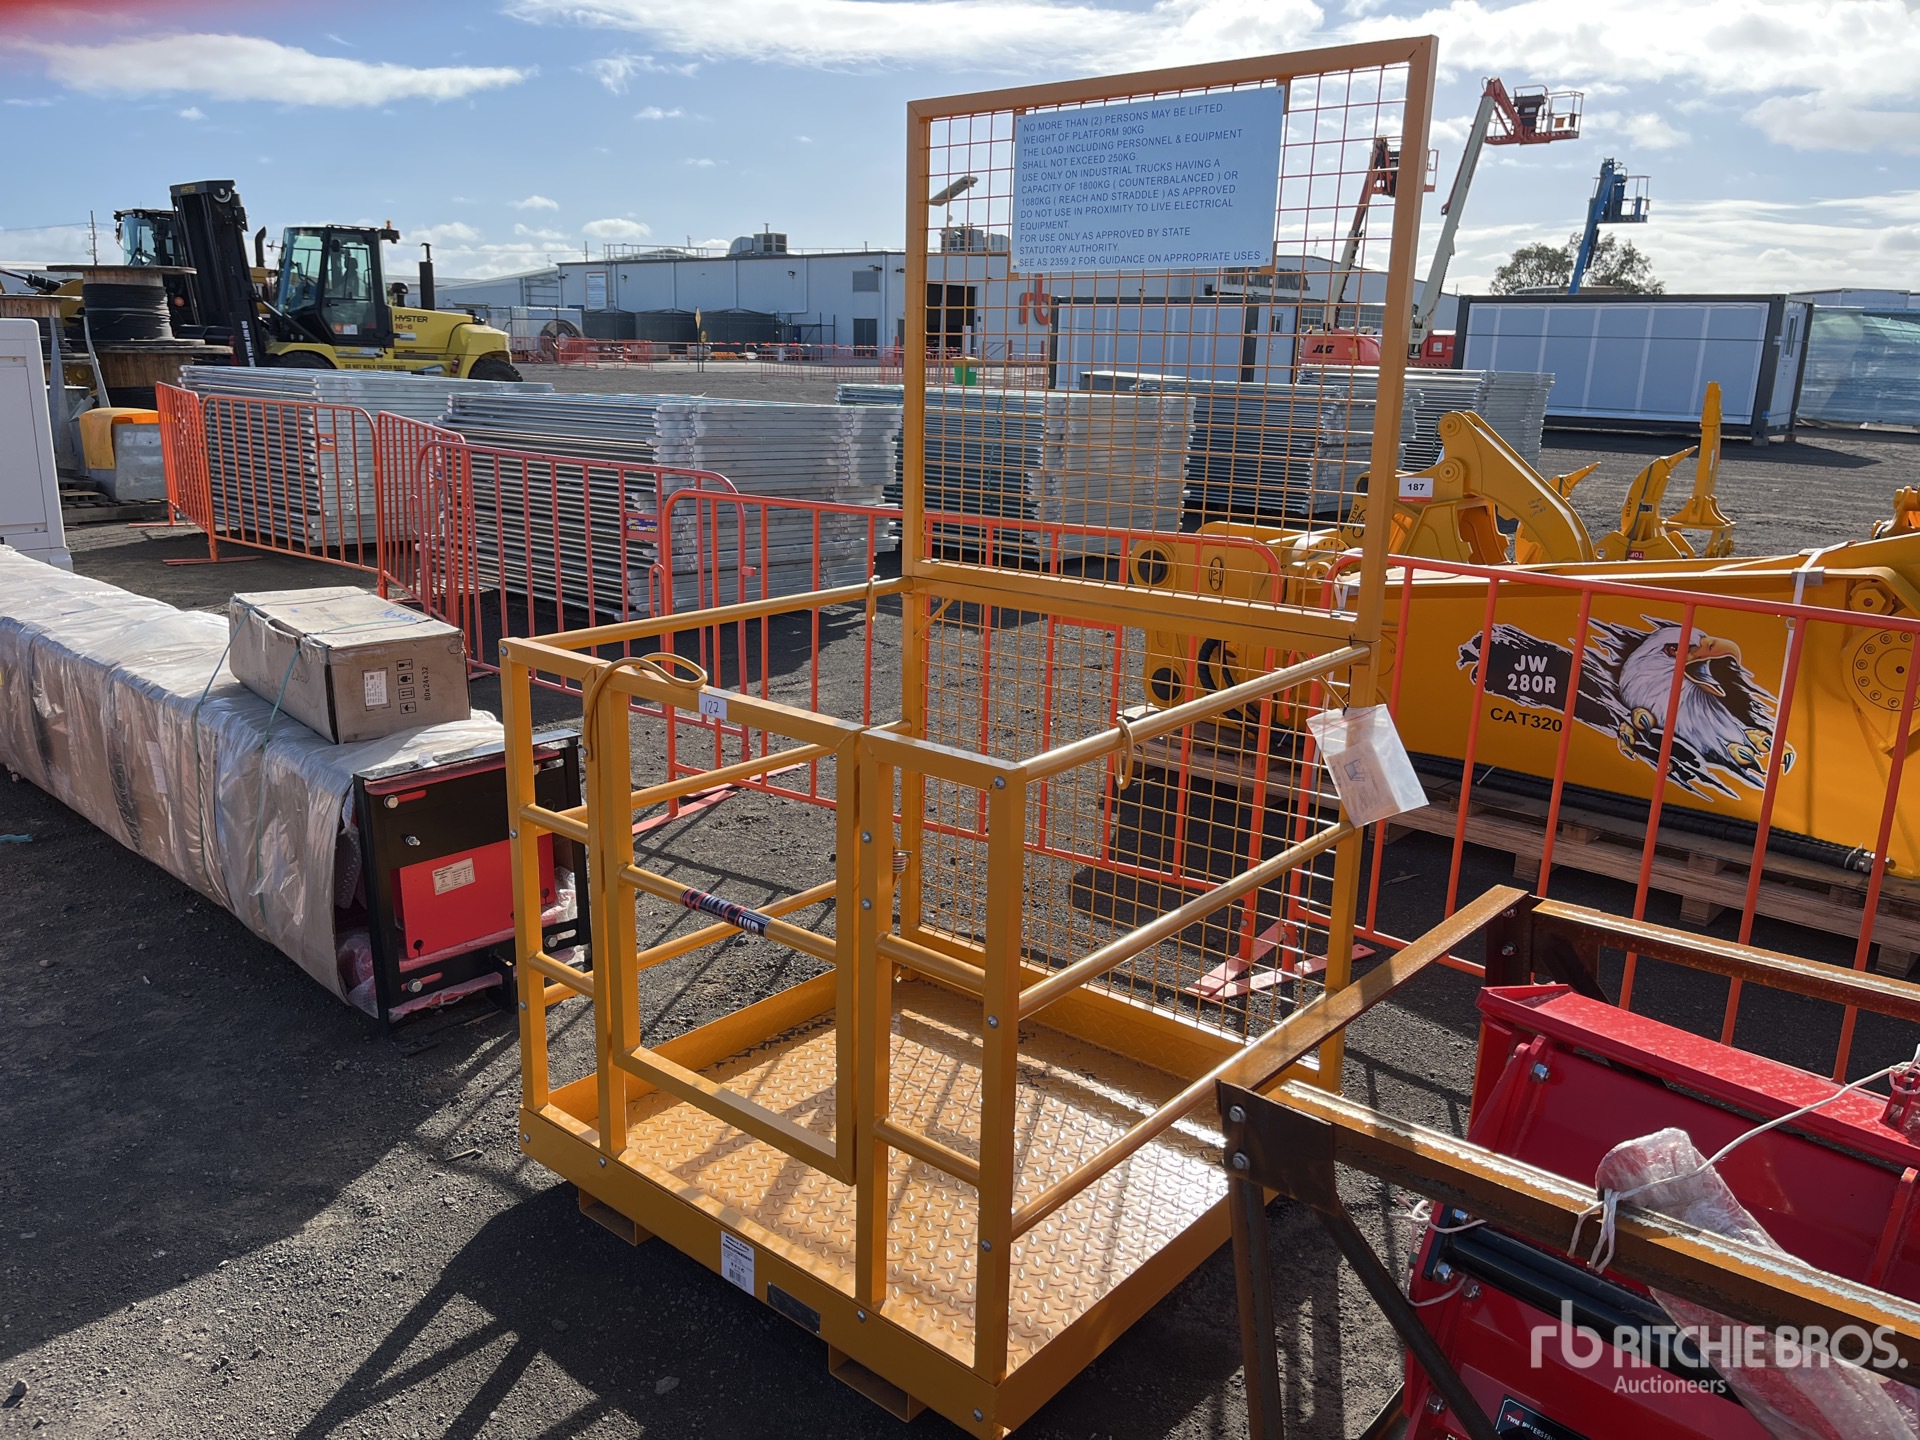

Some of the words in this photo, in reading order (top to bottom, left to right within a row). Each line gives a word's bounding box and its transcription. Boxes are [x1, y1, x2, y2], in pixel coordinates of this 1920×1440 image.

[1023, 123, 1036, 132] NO
[1037, 120, 1062, 131] MORE
[1065, 117, 1088, 128] THAN
[1090, 115, 1102, 127] (2)
[1104, 110, 1148, 124] PERSONS
[1151, 108, 1171, 119] MAY
[1172, 106, 1186, 117] BE
[1188, 102, 1226, 115] LIFTED.
[1022, 133, 1056, 145] WEIGHT
[1057, 131, 1069, 141] OF
[1072, 126, 1119, 140] PLATFORM
[1121, 124, 1144, 135] 90KG
[1022, 147, 1038, 157] THE
[1041, 145, 1064, 156] LOAD
[1066, 140, 1114, 153] INCLUDING
[1116, 134, 1173, 149] PERSONNEL
[1175, 134, 1181, 144] &
[1184, 128, 1243, 143] EQUIPMENT
[1021, 172, 1038, 182] USE
[1040, 170, 1063, 180] ONLY
[1064, 169, 1077, 179] ON
[1080, 164, 1132, 177] INDUSTRIAL
[1134, 161, 1173, 173] TRUCKS
[1175, 158, 1211, 170] HAVING
[1213, 157, 1221, 167] A
[1022, 159, 1048, 170] SHALL
[1050, 157, 1067, 167] NOT
[1070, 154, 1105, 166] EXCEED
[1021, 183, 1062, 194] CAPACITY
[1063, 182, 1075, 191] OF
[1078, 179, 1110, 190] 1800KG
[1118, 171, 1214, 187] COUNTERBALANCED
[1223, 170, 1238, 180] OR
[1021, 196, 1051, 206] 1080KG
[1058, 193, 1087, 204] REACH
[1090, 192, 1108, 202] AND
[1111, 189, 1159, 201] STRADDLE
[1167, 187, 1180, 197] AS
[1020, 209, 1032, 218] DO
[1034, 208, 1052, 218] NOT
[1054, 207, 1071, 217] USE
[1073, 206, 1083, 215] IN
[1085, 203, 1133, 215] PROXIMITY
[1136, 202, 1148, 212] TO
[1150, 201, 1171, 211] LIVE
[1174, 197, 1233, 210] ELECTRICAL
[1019, 233, 1036, 243] FOR
[1038, 232, 1055, 242] USE
[1057, 231, 1080, 241] ONLY
[1081, 231, 1093, 240] AS
[1095, 228, 1144, 240] APPROVED
[1146, 228, 1159, 237] BY
[1161, 226, 1190, 237] STATE
[1018, 257, 1034, 266] SEE
[1036, 257, 1047, 266] AS
[1078, 255, 1096, 265] FOR
[1098, 254, 1145, 264] GUIDANCE
[1147, 253, 1161, 263] ON
[1163, 251, 1230, 262] APPROPRIATE
[1233, 250, 1261, 260] USES
[1019, 244, 1067, 254] STATUTORY
[395, 315, 428, 323] HYSTER
[1312, 344, 1335, 354] JLG
[1408, 483, 1425, 491] 187
[1514, 654, 1548, 673] JW
[421, 666, 431, 701] 80x24x32
[1507, 673, 1557, 694] 280R
[1490, 707, 1563, 732] CAT320
